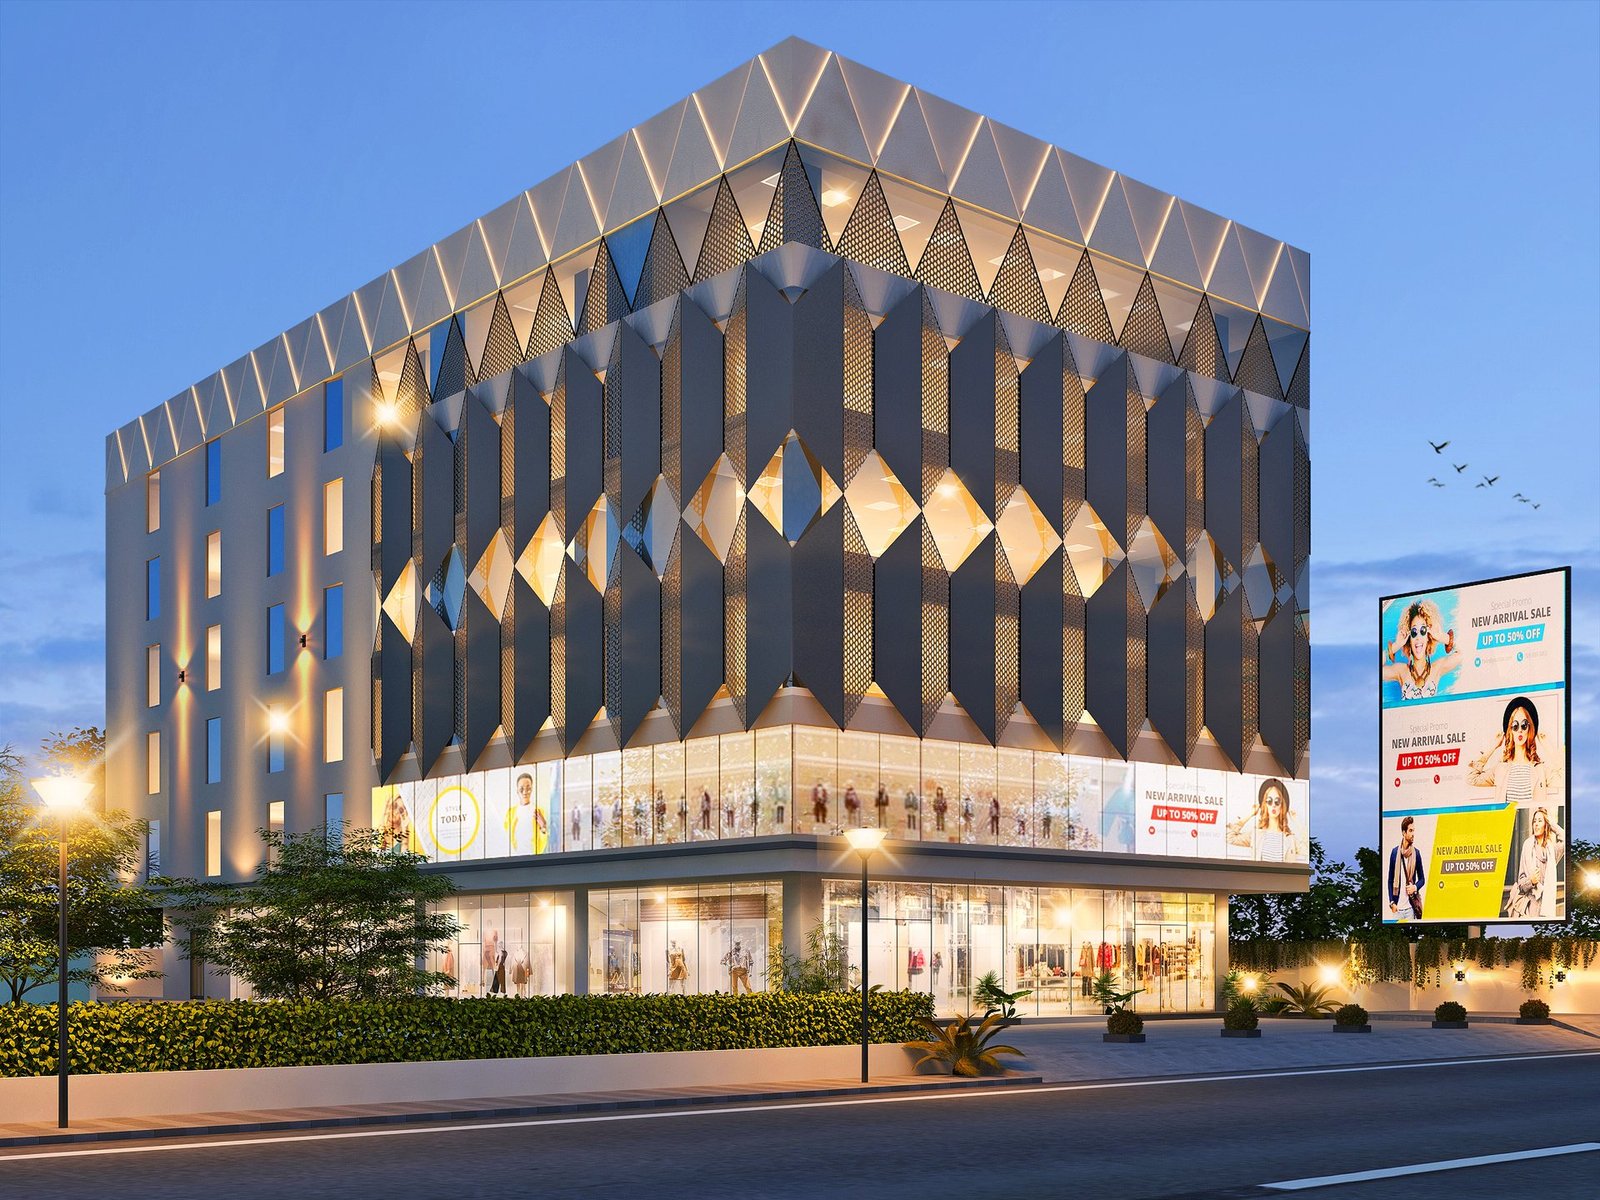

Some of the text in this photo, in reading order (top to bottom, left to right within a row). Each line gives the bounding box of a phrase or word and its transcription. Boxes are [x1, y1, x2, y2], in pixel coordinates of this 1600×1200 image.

[1471, 606, 1551, 628] NEW ARRIVAL SALE
[1482, 628, 1541, 646] UP TO 50% OFF
[1392, 732, 1466, 750] NEW ARRIVAL SALE
[1402, 752, 1456, 766] UP TO 50% OFF
[1145, 790, 1224, 806] NEW ARRIVAL SALE
[440, 814, 467, 824] TODAY
[1157, 809, 1214, 822] UP TO 50% OFF
[1436, 843, 1502, 856] NEW ARRIVAL SALE
[1445, 861, 1494, 871] UP TO 50% OFF
